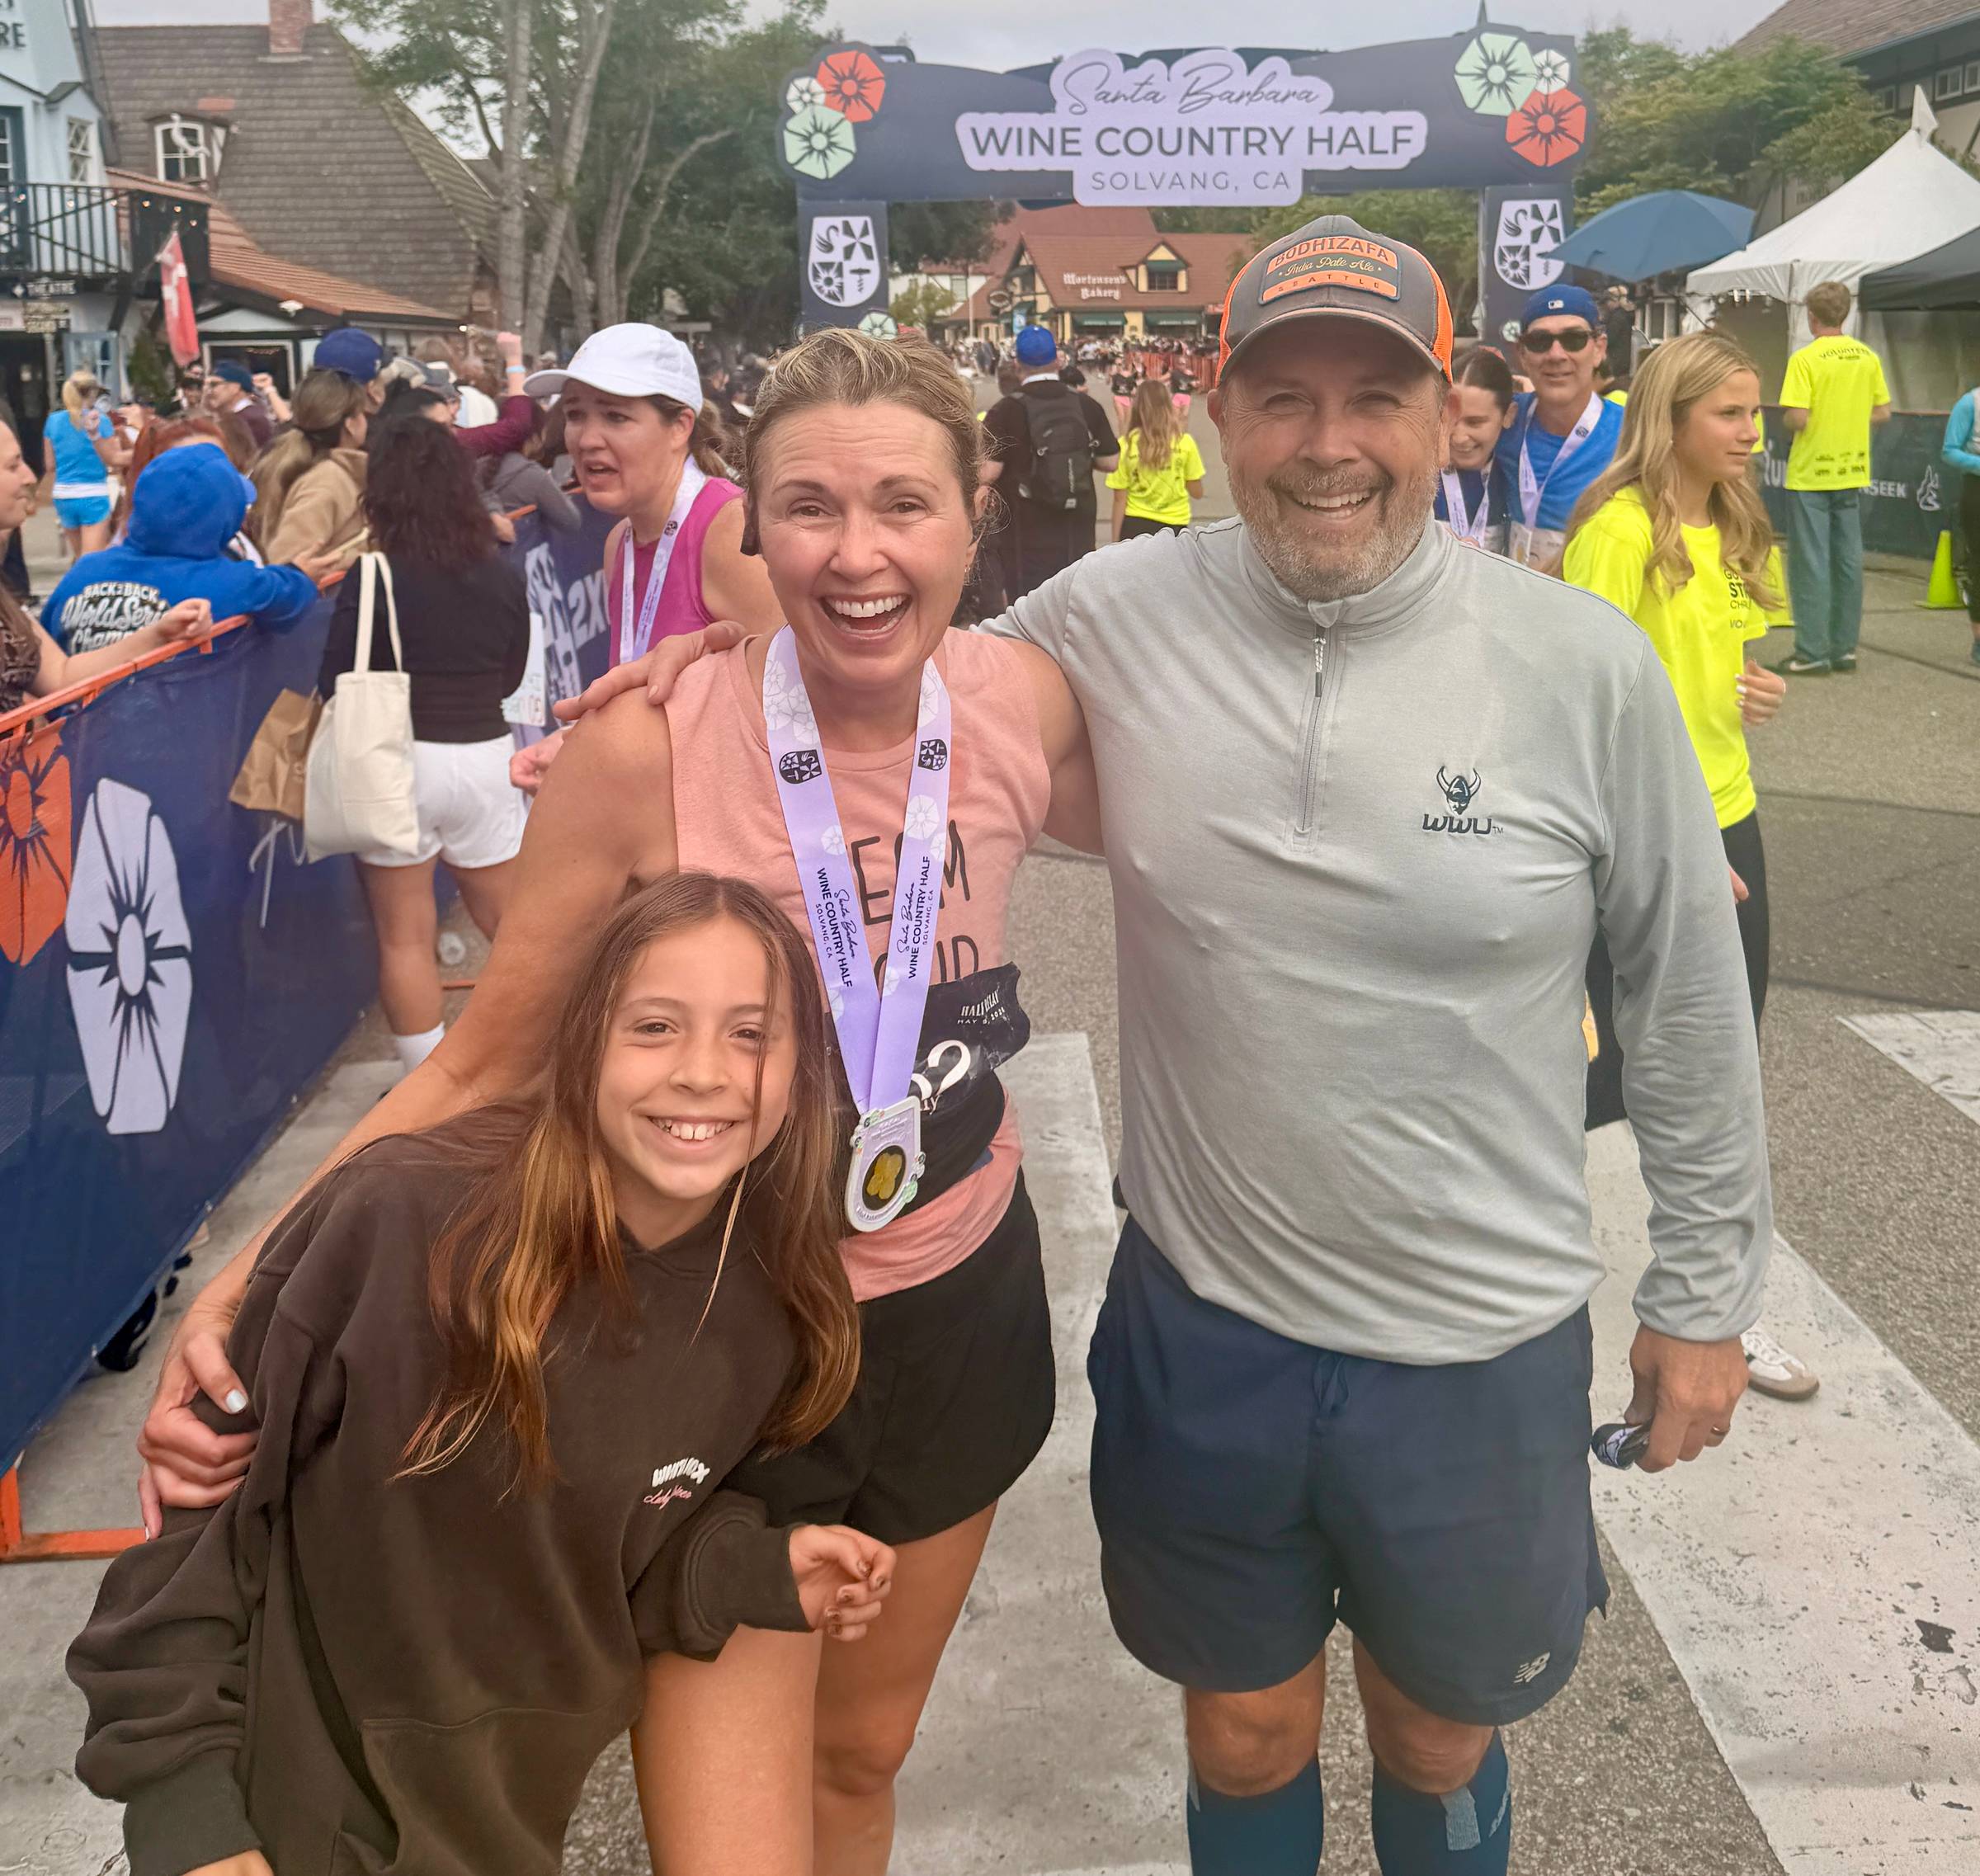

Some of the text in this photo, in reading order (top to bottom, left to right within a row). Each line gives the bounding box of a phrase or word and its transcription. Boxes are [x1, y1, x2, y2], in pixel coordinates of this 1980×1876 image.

[1063, 61, 1319, 115] Santa Barbara
[970, 125, 1413, 157] WINE COUNTRY HALF
[1091, 171, 1290, 191] SOLVANG, CA
[1275, 237, 1388, 266] BODHIZAFA
[1285, 257, 1374, 276] India Pale Ale
[1081, 286, 1120, 300] Bakery
[1279, 273, 1380, 291] SEATTLE
[61, 595, 168, 630] World Seri
[1422, 813, 1492, 835] WWU
[927, 889, 934, 902] CA
[817, 867, 853, 987] WINE COUNTRY HALF
[908, 856, 931, 979] WINE COUNTRY HALF
[826, 947, 832, 959] CA
